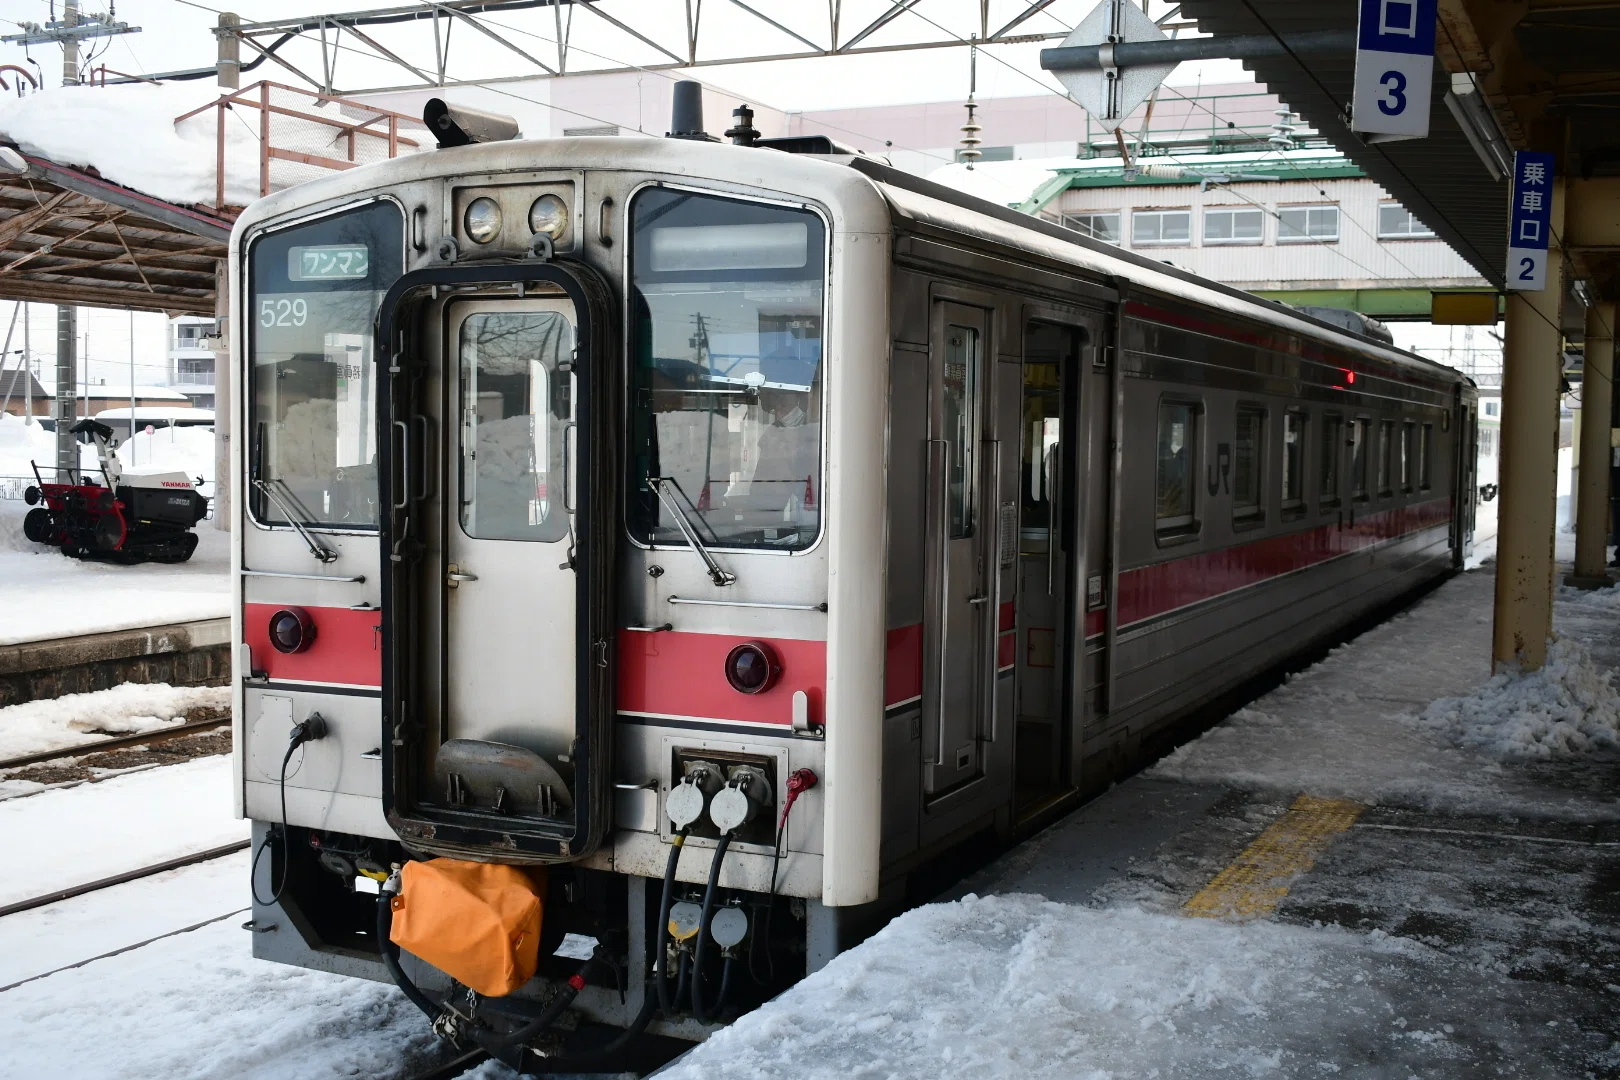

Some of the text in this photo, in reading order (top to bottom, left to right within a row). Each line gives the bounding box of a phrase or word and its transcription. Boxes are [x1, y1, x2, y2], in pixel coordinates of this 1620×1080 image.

[1378, 71, 1407, 116] 3
[1520, 162, 1546, 242] 乗車口
[303, 251, 369, 274] ワンマン
[1519, 257, 1535, 280] 2
[260, 298, 308, 327] 529
[1207, 443, 1231, 497] JR
